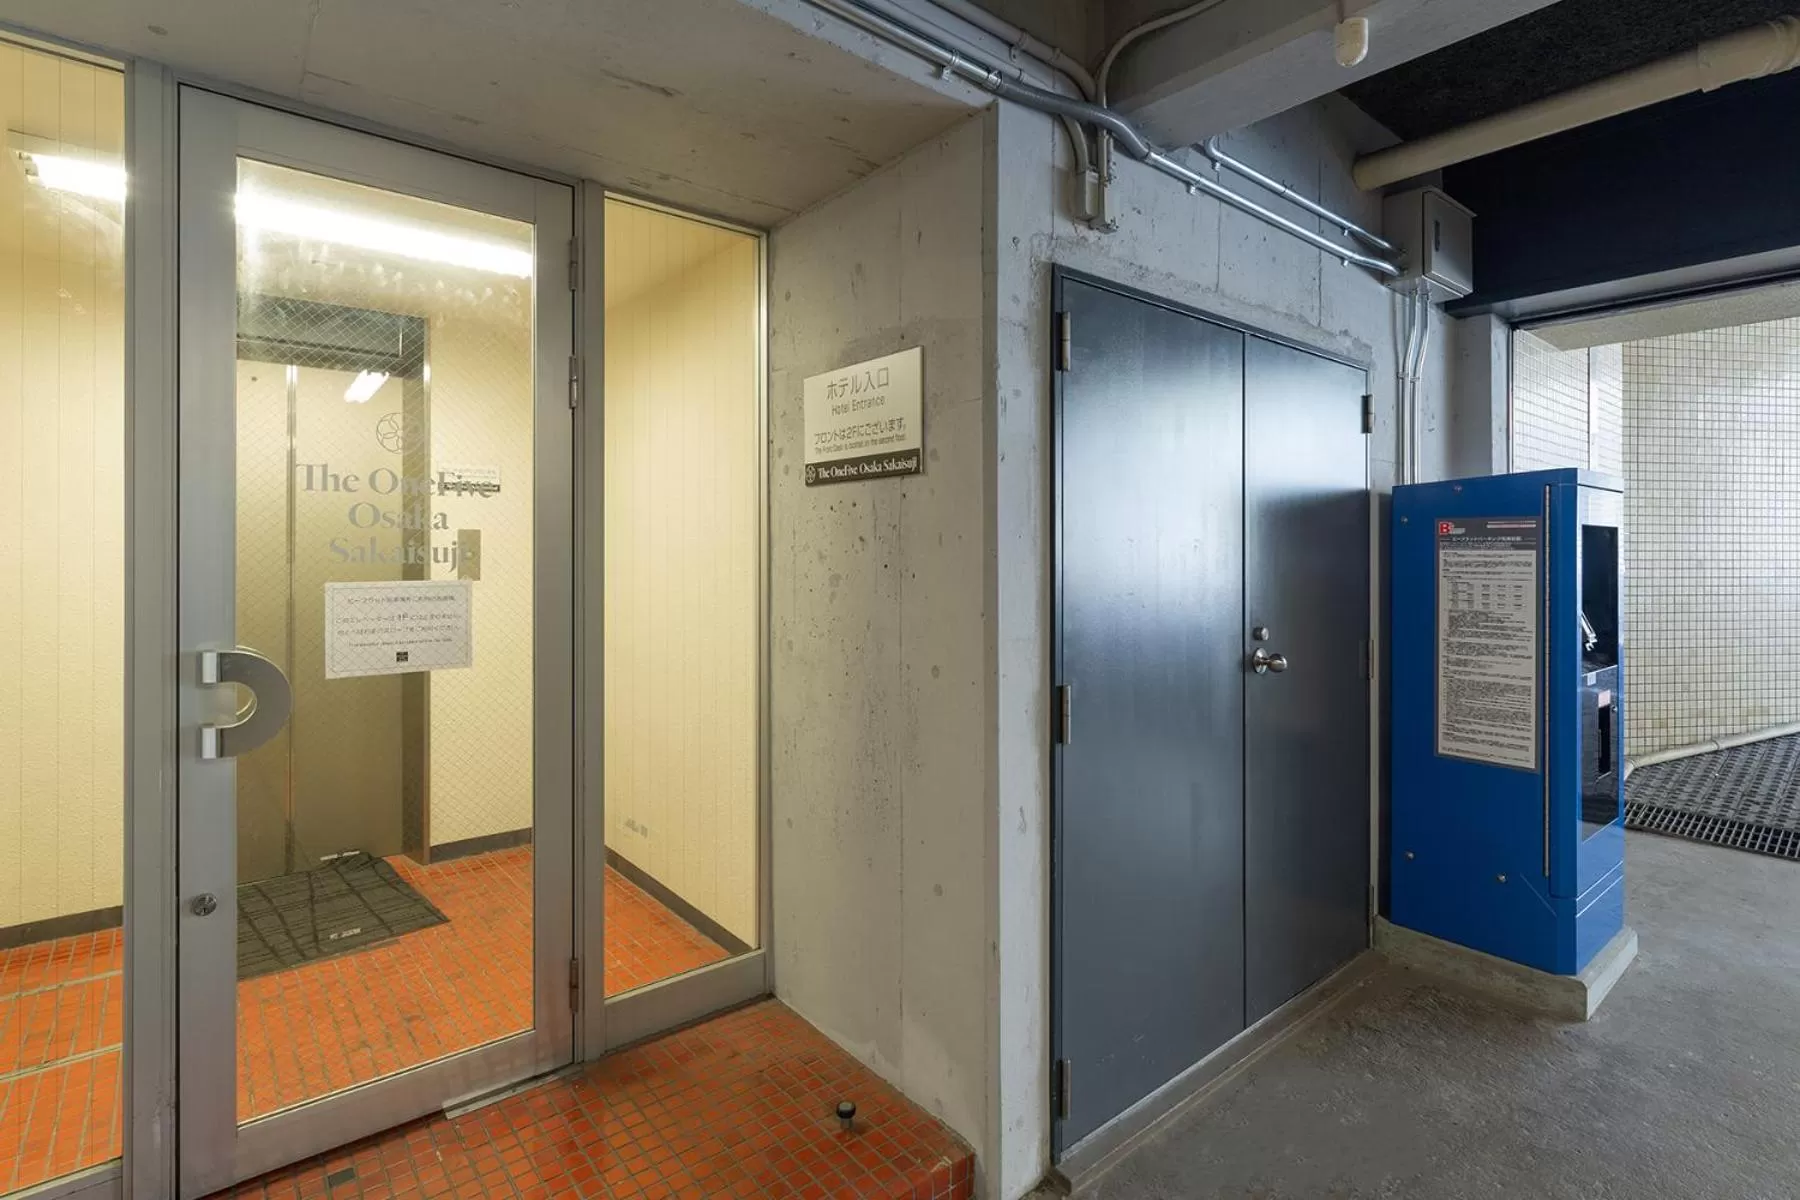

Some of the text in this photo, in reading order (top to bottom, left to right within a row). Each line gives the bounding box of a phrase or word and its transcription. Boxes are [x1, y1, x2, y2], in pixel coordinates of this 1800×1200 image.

[827, 367, 889, 400] ホテル入口
[831, 396, 885, 417] Hotel Entrance
[296, 463, 494, 499] The OneFive
[818, 456, 918, 479] The OneFive Osaka Sakaisuji
[348, 501, 450, 530] Osaka
